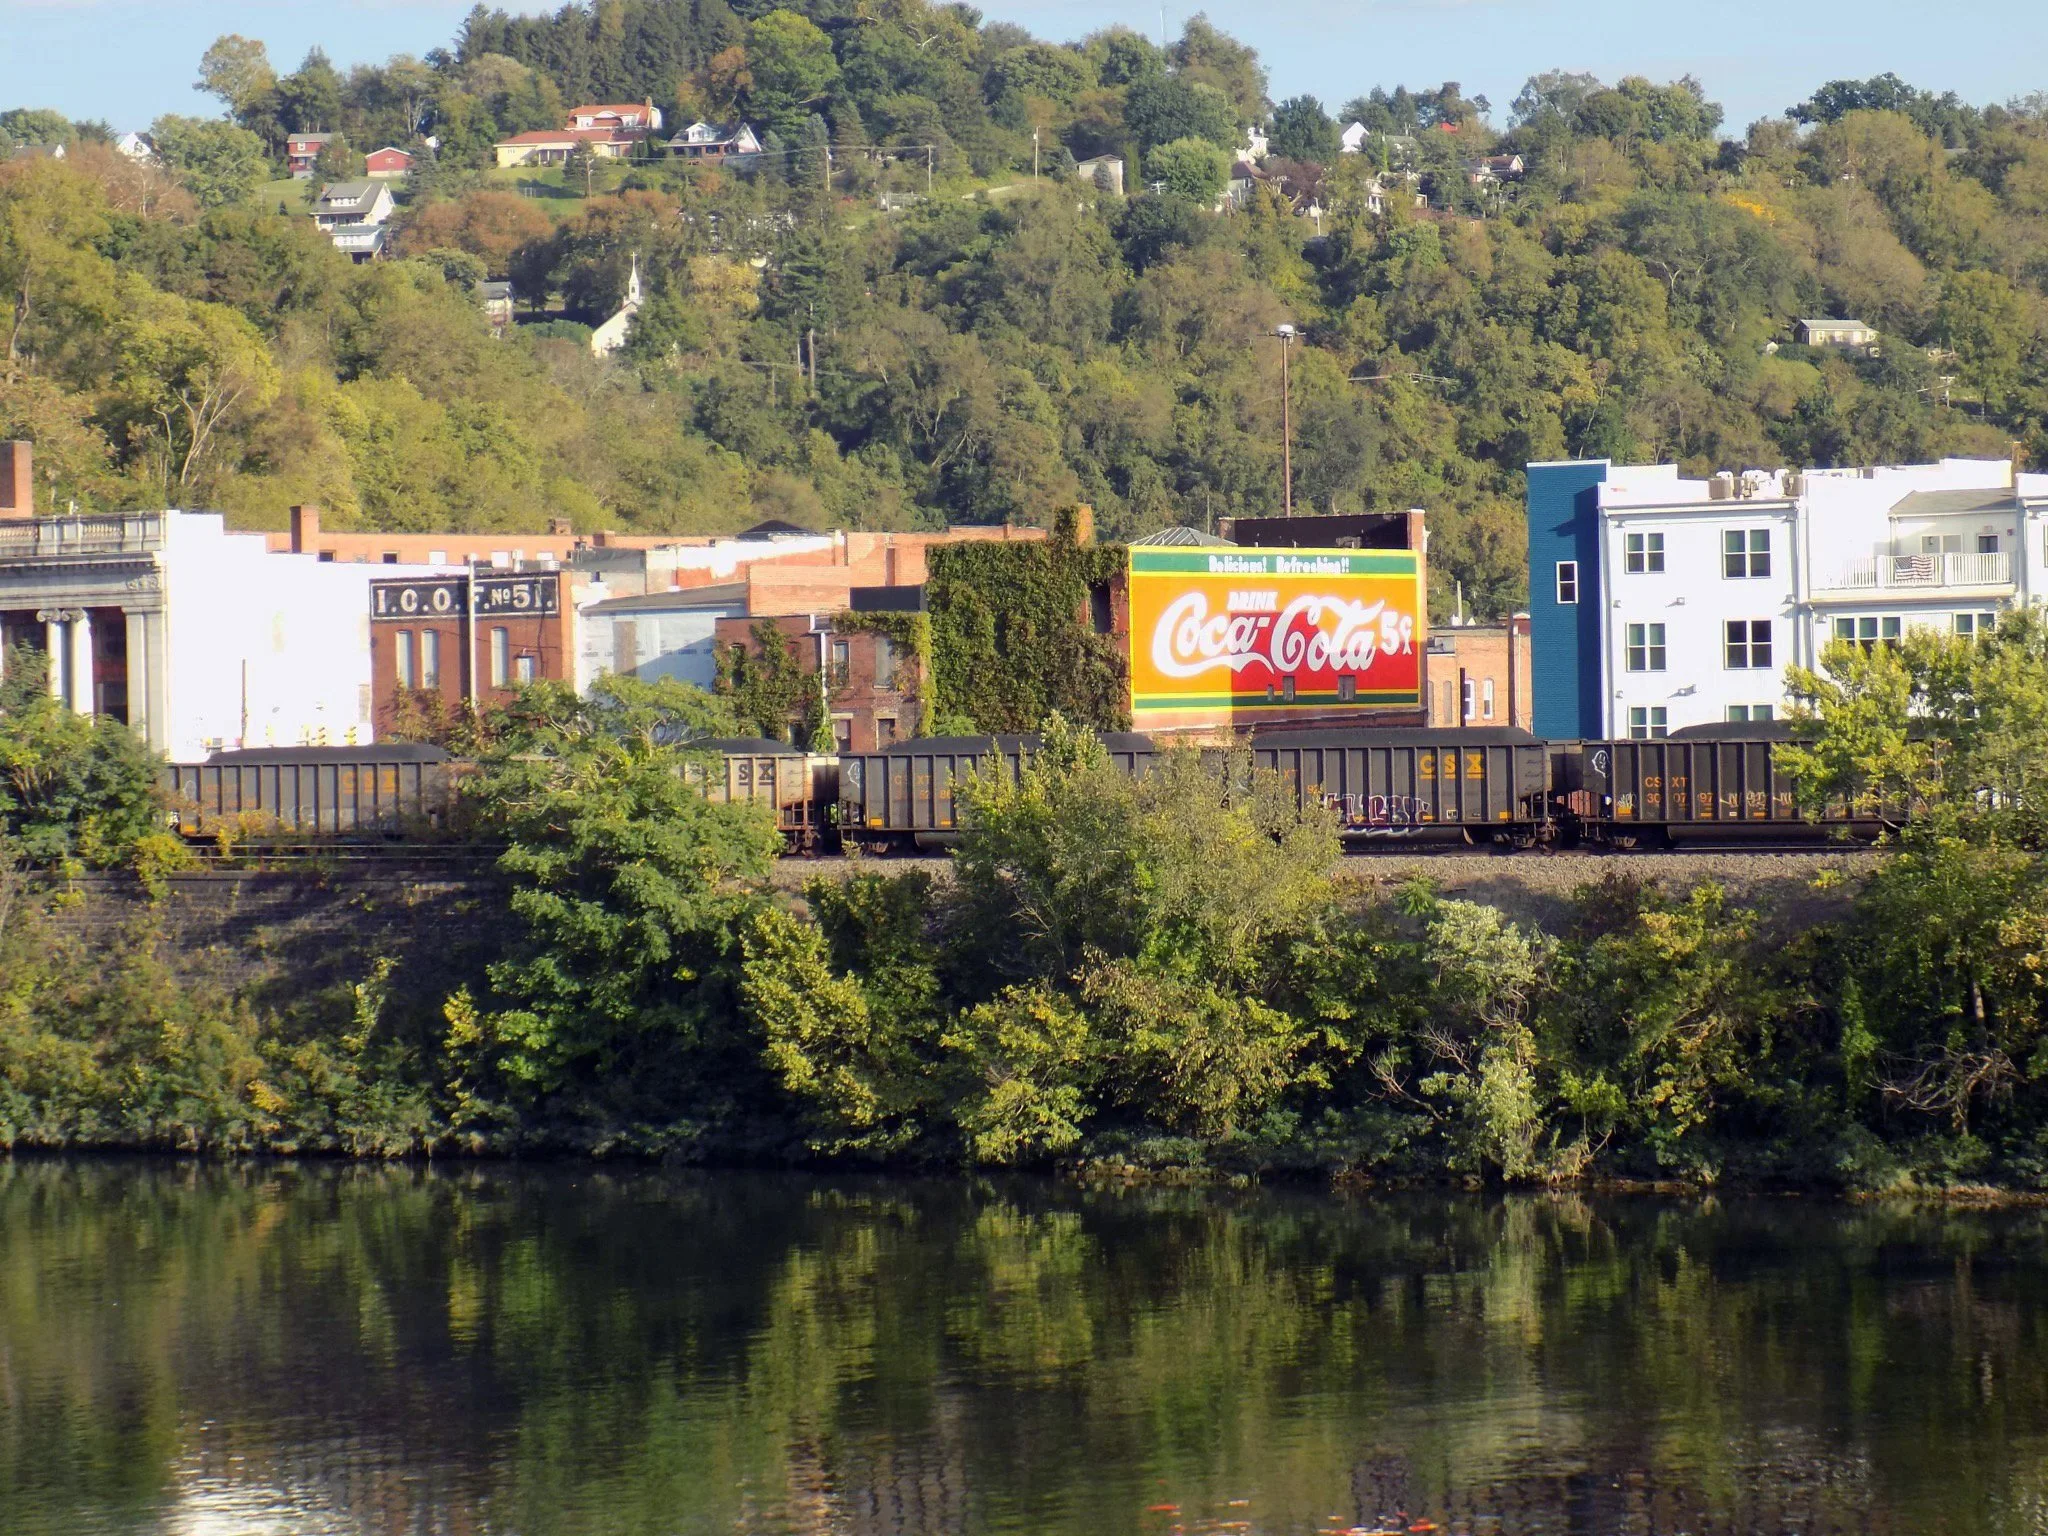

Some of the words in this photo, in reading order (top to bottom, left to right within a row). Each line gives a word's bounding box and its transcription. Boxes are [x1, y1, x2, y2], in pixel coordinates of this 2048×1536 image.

[1227, 591, 1278, 611] DRINK
[1151, 591, 1385, 678] Coca-Cola
[1420, 753, 1484, 779] CSX
